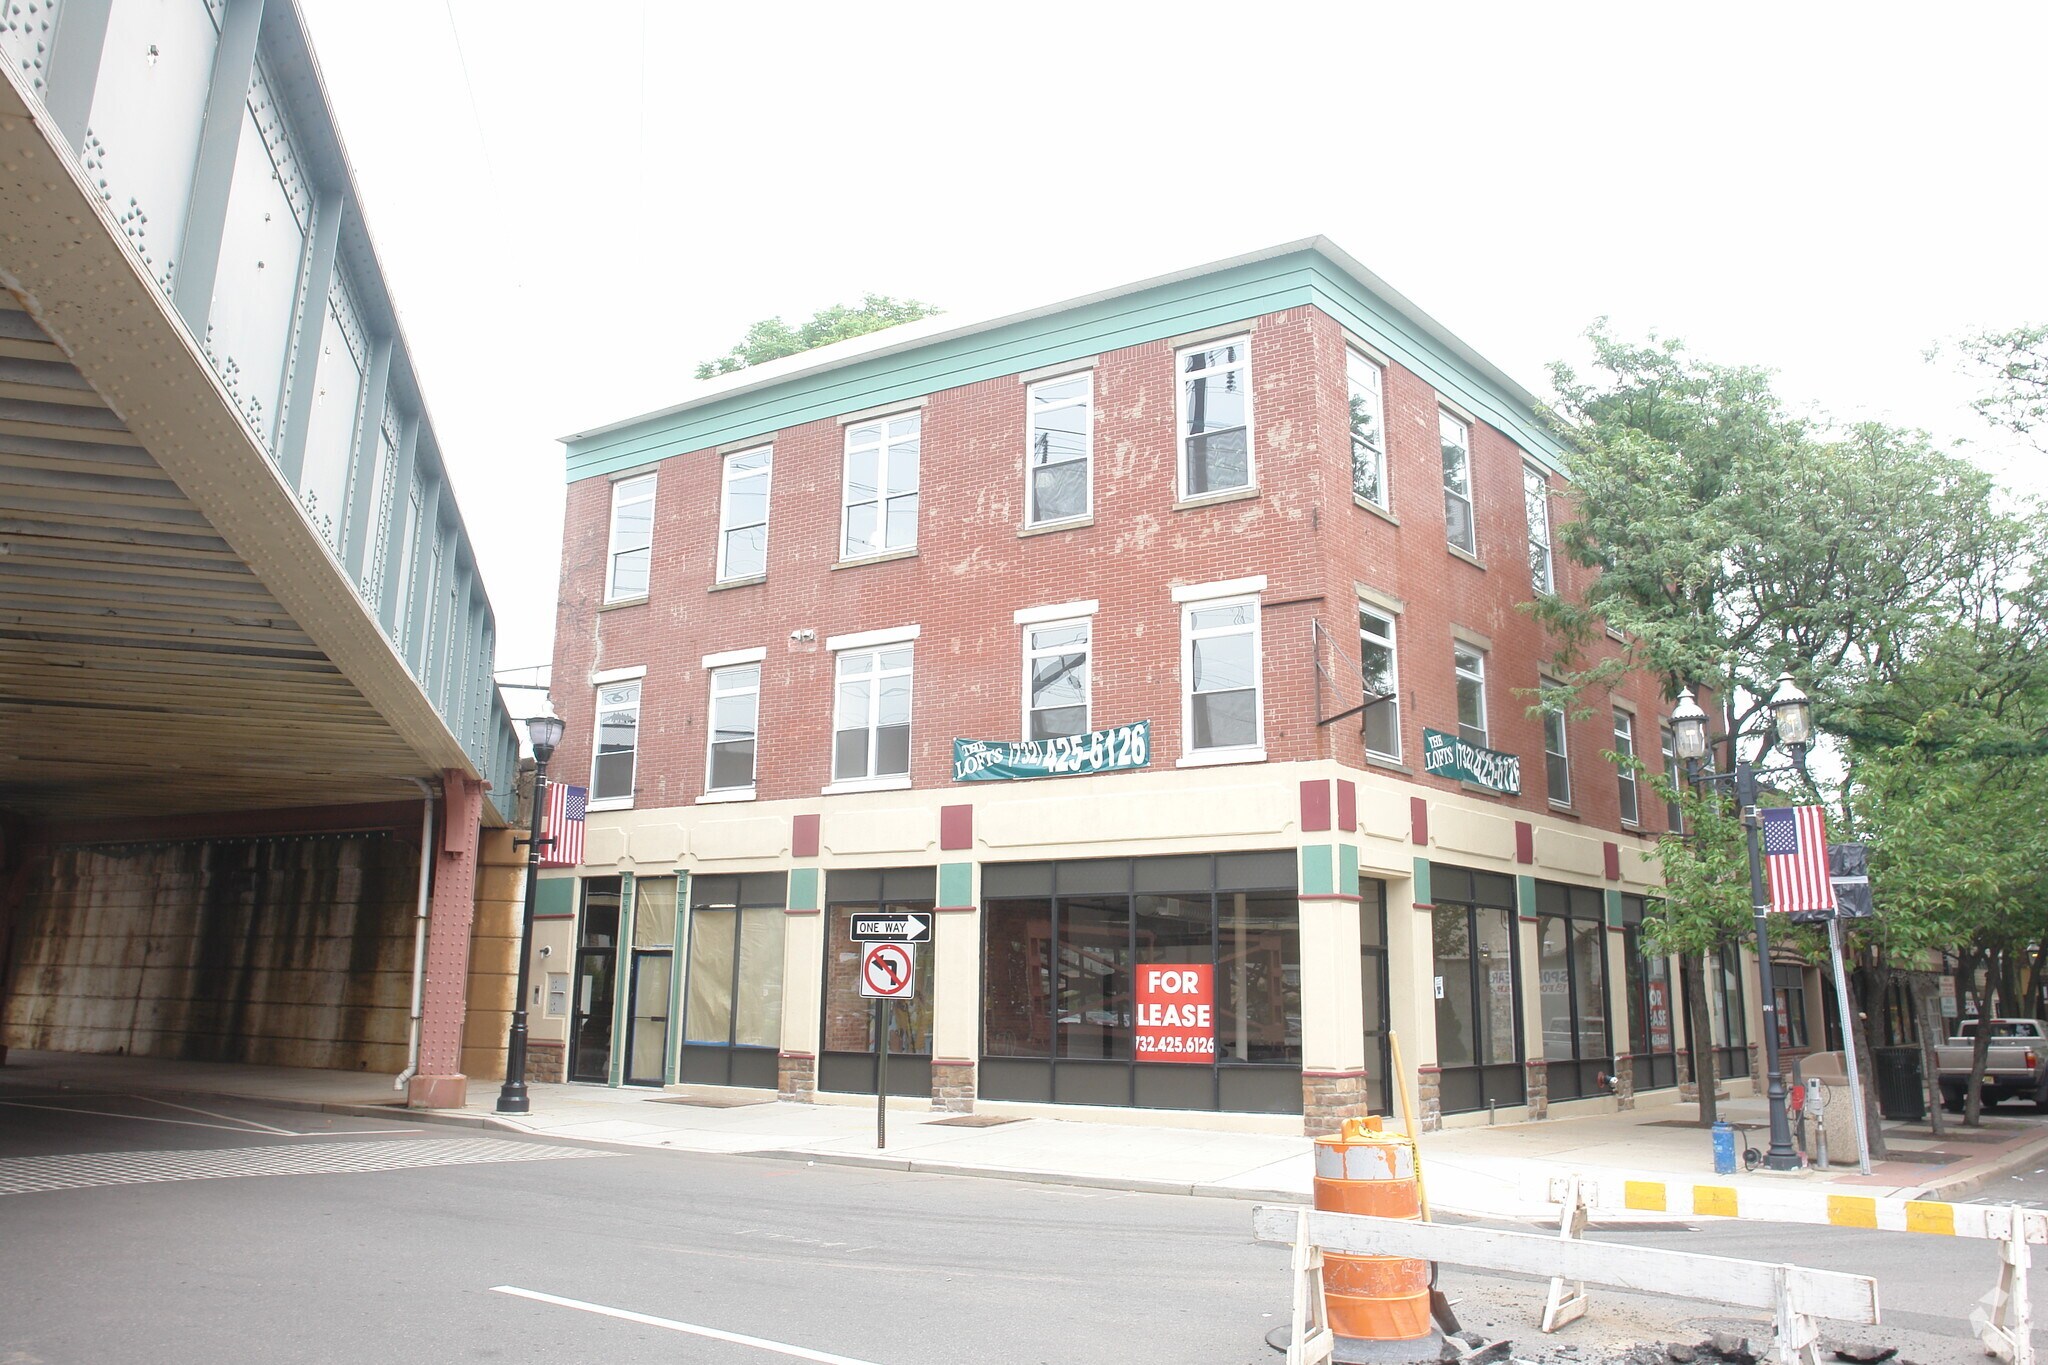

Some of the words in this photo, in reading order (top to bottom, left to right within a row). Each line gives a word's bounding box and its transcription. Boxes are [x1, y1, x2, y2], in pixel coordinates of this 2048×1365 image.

[961, 740, 987, 757] THE
[1008, 741, 1043, 768] (732)
[1042, 724, 1146, 773] 425-6126
[1427, 734, 1444, 748] THE
[954, 746, 1004, 779] LOFTS
[1425, 745, 1454, 770] LOFTS
[859, 922, 879, 933] ONE
[885, 922, 906, 933] WAY
[1148, 971, 1199, 994] FOR
[1137, 1003, 1211, 1028] LEASE
